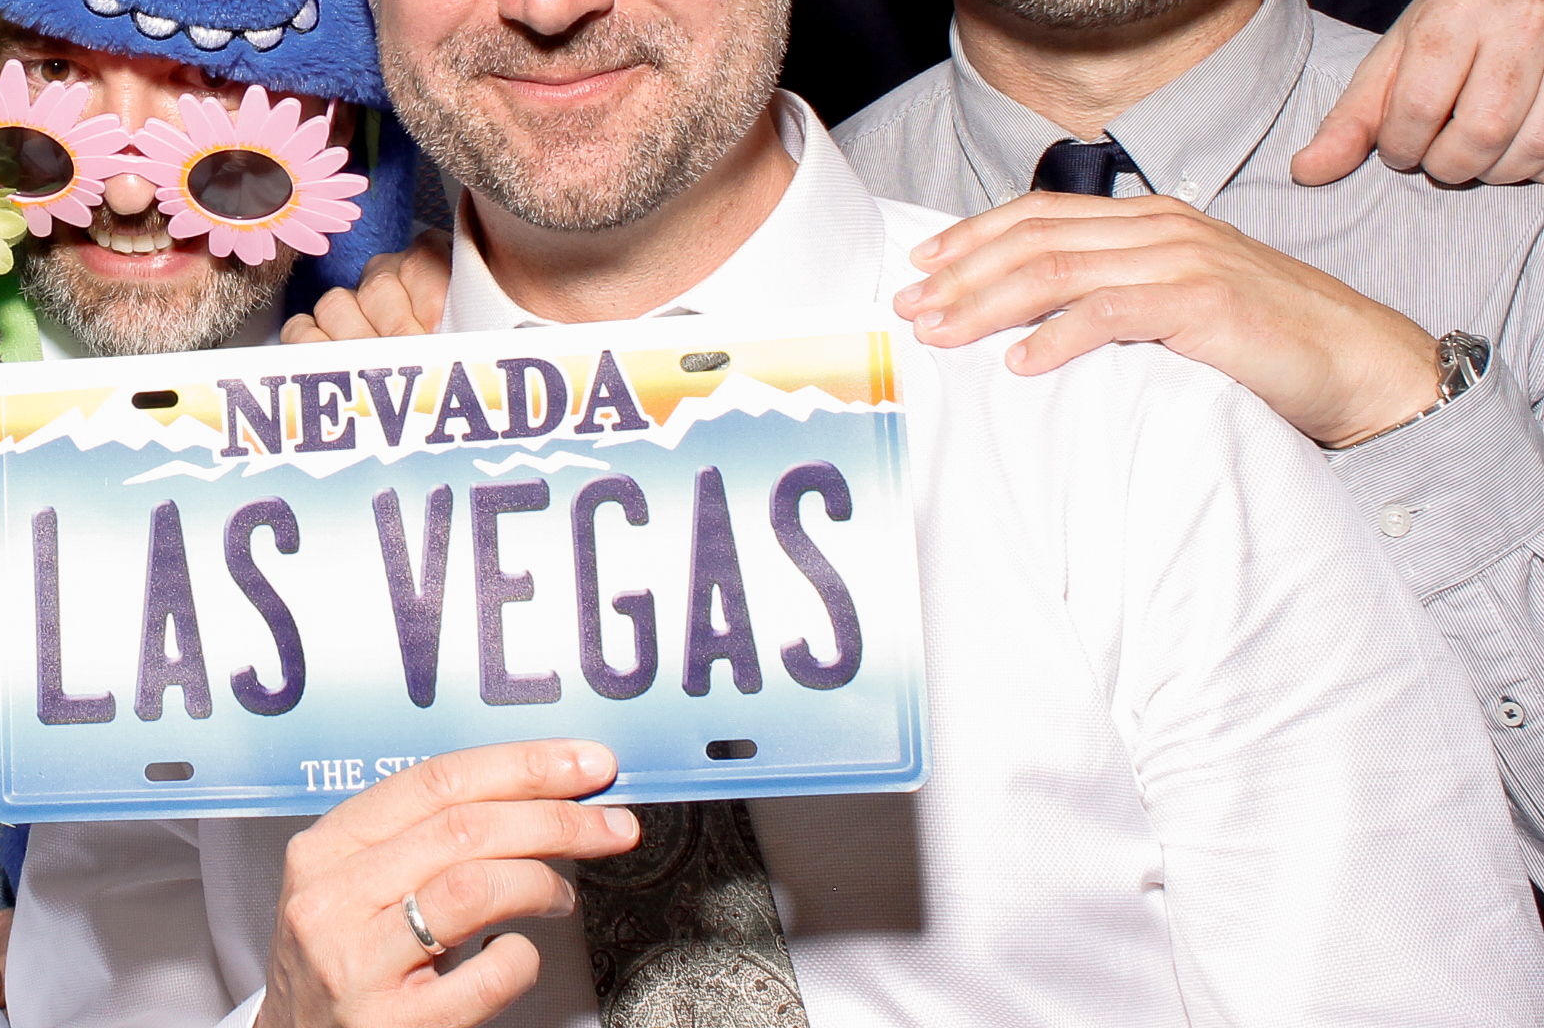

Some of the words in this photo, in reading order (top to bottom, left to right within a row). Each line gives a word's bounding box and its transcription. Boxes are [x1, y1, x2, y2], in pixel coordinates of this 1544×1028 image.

[217, 349, 650, 458] NEVADA
[31, 495, 306, 725] LAS
[371, 459, 863, 708] VEGAS
[300, 758, 366, 792] THE
